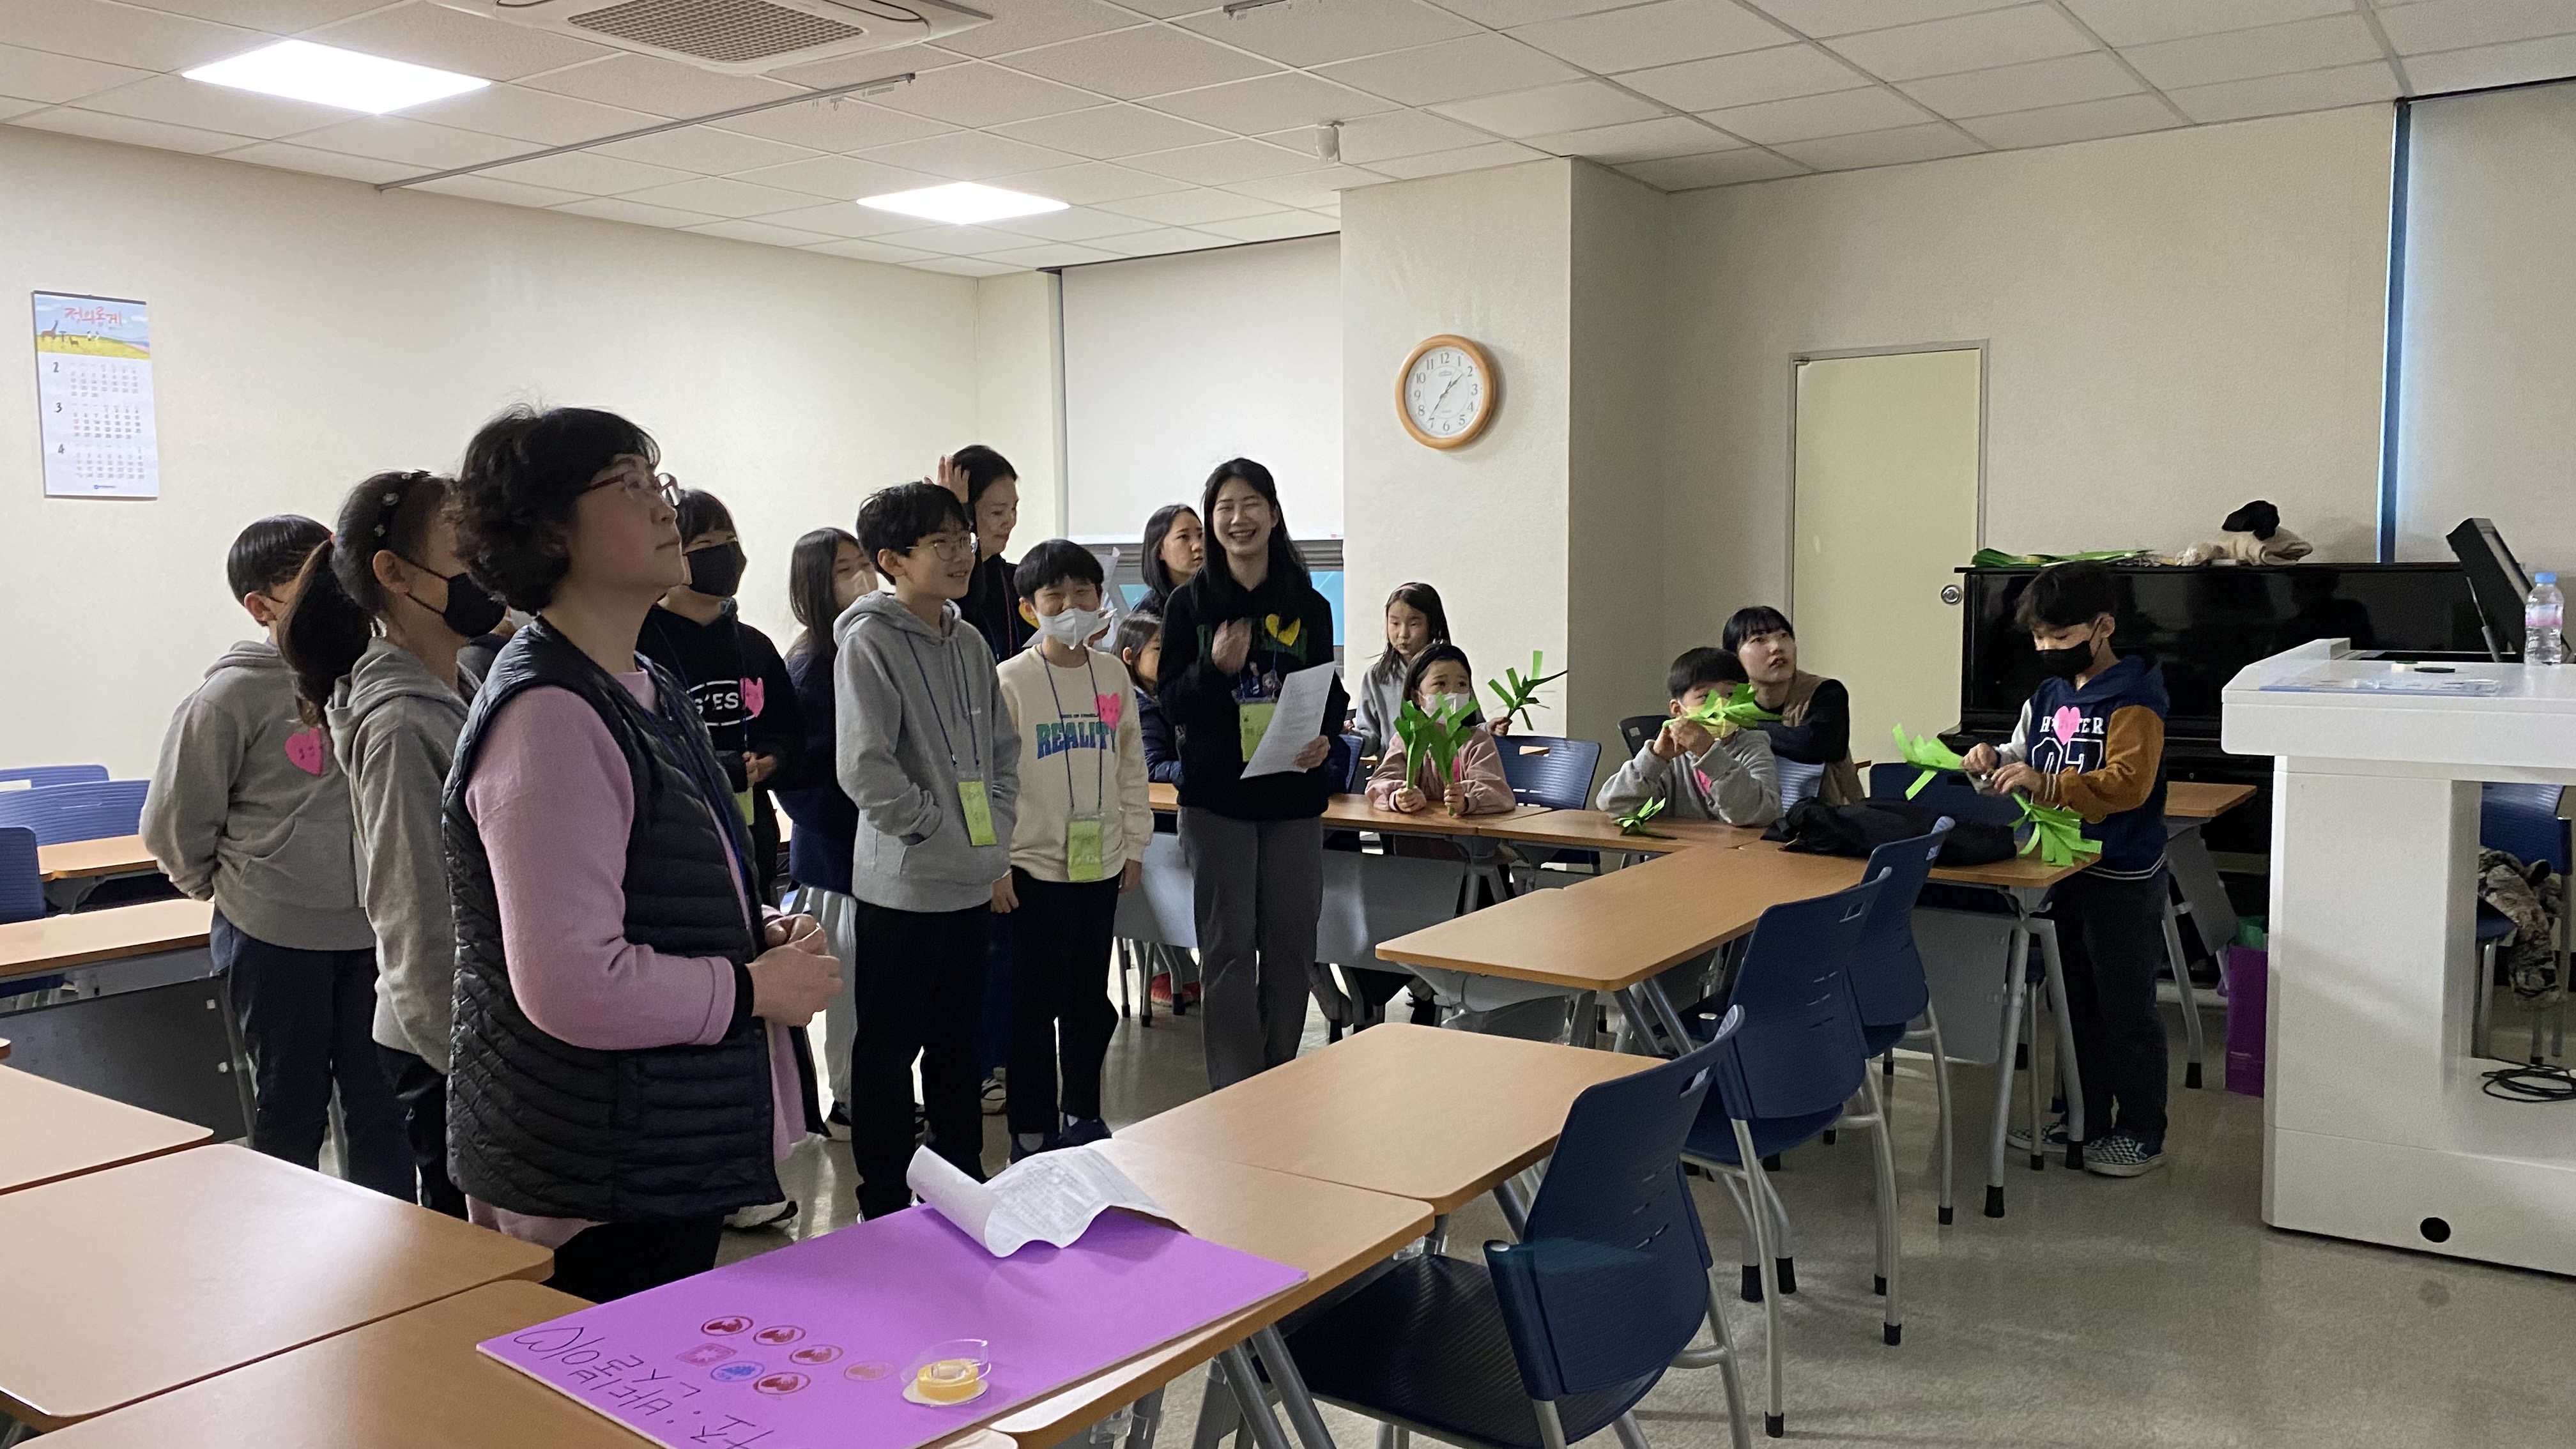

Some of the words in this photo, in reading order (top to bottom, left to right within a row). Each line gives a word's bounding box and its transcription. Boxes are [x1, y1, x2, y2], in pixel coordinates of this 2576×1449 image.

[1440, 352, 1450, 364] 12
[1457, 355, 1460, 366] 1
[53, 362, 59, 372] 2
[1427, 358, 1434, 370] 11
[1468, 365, 1473, 377] 2
[1416, 372, 1426, 384] 10
[1471, 383, 1478, 395] 3
[1414, 390, 1421, 400] 9
[55, 402, 62, 413] 3
[1418, 404, 1425, 416] 8
[1467, 401, 1473, 412] 4
[1429, 417, 1434, 428] 7
[1443, 420, 1450, 431] 6
[1459, 415, 1466, 425] 5
[57, 444, 65, 454] 4
